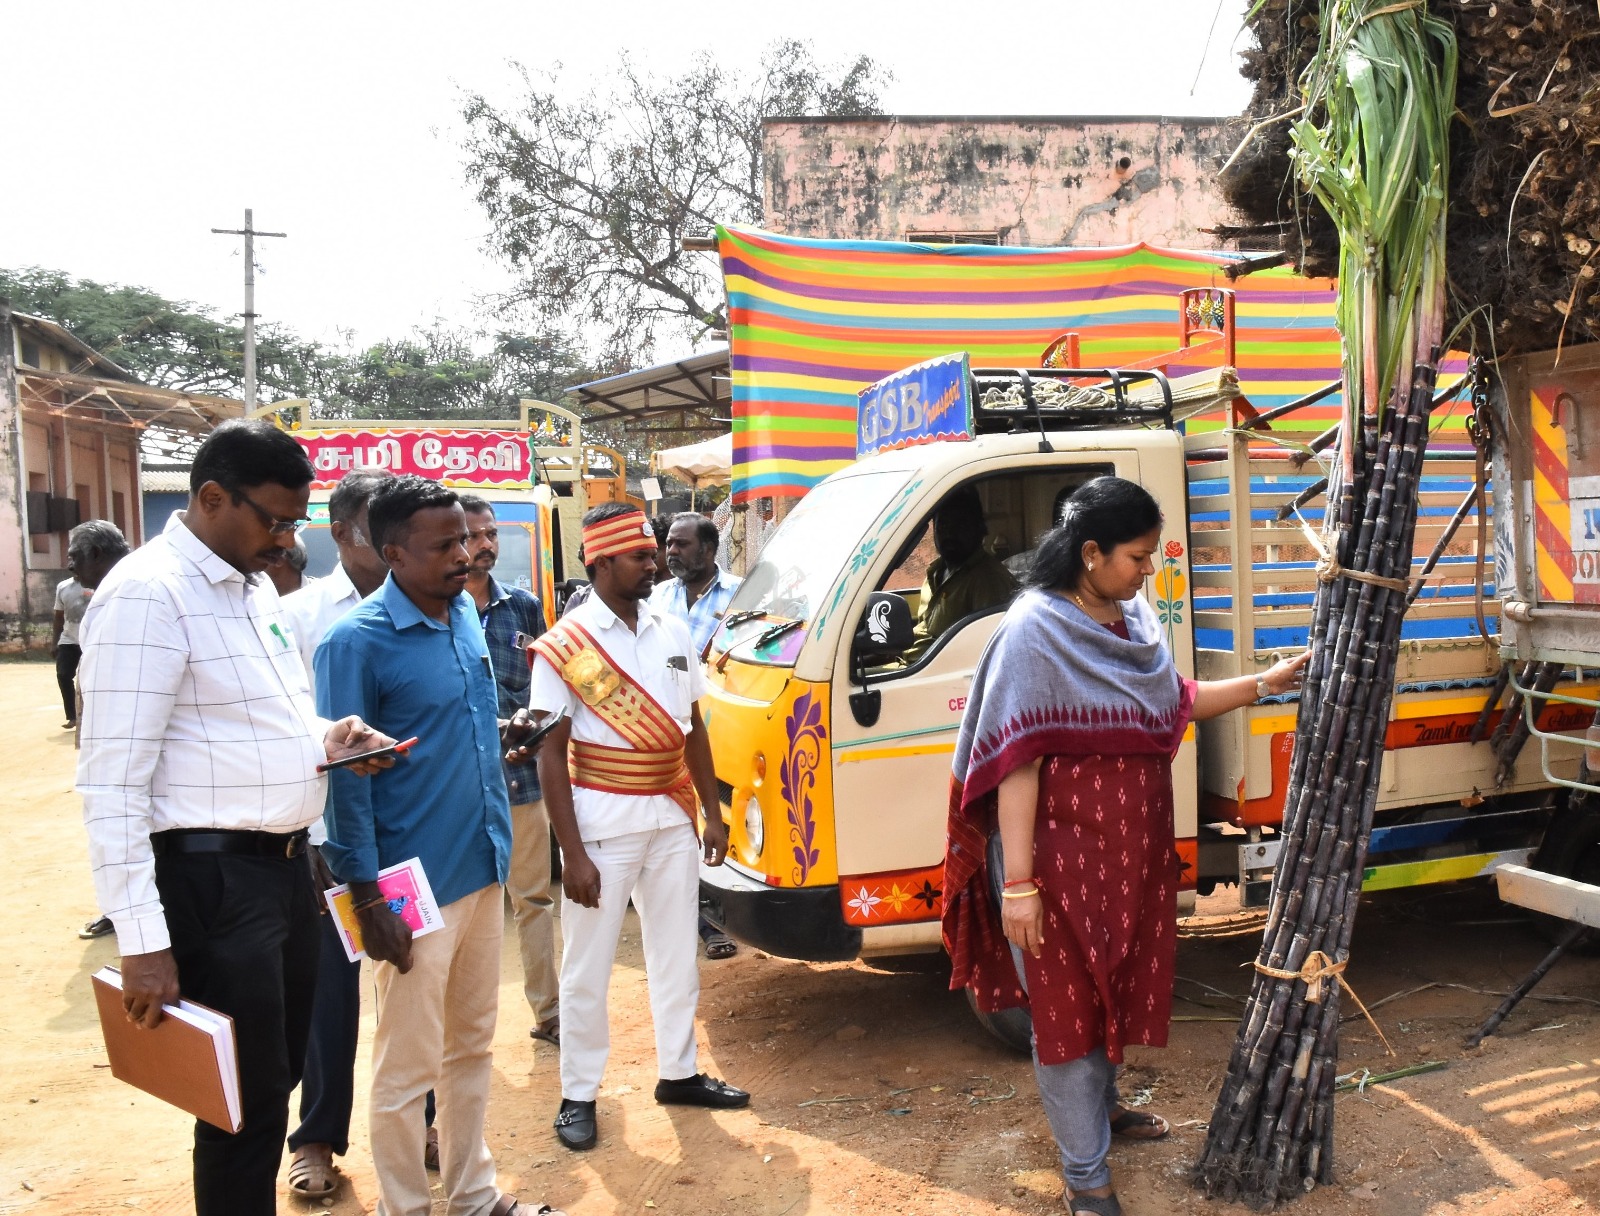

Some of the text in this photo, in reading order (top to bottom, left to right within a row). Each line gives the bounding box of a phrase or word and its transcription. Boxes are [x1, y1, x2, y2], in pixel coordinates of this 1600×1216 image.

[861, 382, 924, 444] GSB
[301, 438, 521, 479] சுமி தேவி
